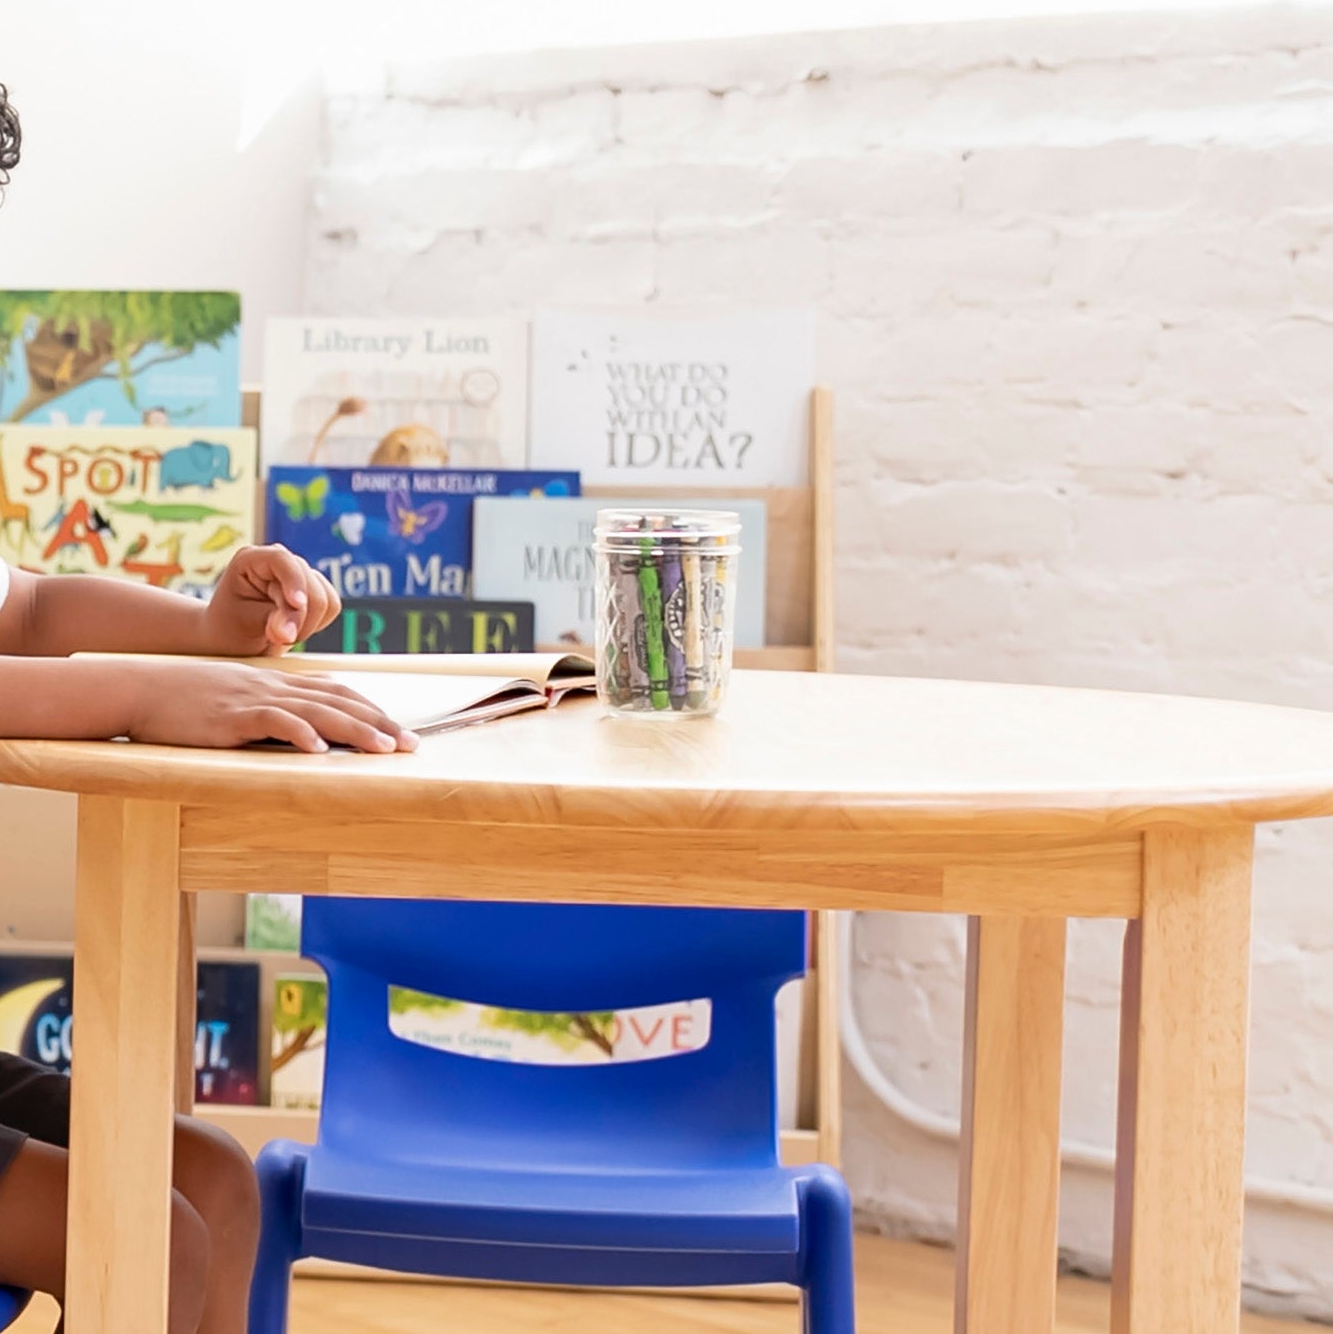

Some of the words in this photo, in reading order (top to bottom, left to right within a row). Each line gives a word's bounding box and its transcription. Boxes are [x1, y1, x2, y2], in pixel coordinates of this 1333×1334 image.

[302, 328, 412, 359] Library
[424, 329, 490, 355] Lion
[606, 362, 681, 382] WHAT
[687, 363, 728, 382] DO
[606, 384, 668, 407] YOU
[680, 385, 728, 407] DO
[606, 409, 680, 430] WITH
[687, 410, 727, 430] AN
[605, 430, 754, 470] IDEA?
[23, 446, 163, 496] SPOT
[41, 498, 108, 567] A
[316, 553, 393, 597] Ten
[404, 552, 473, 599] Ma
[290, 608, 520, 653] REE
